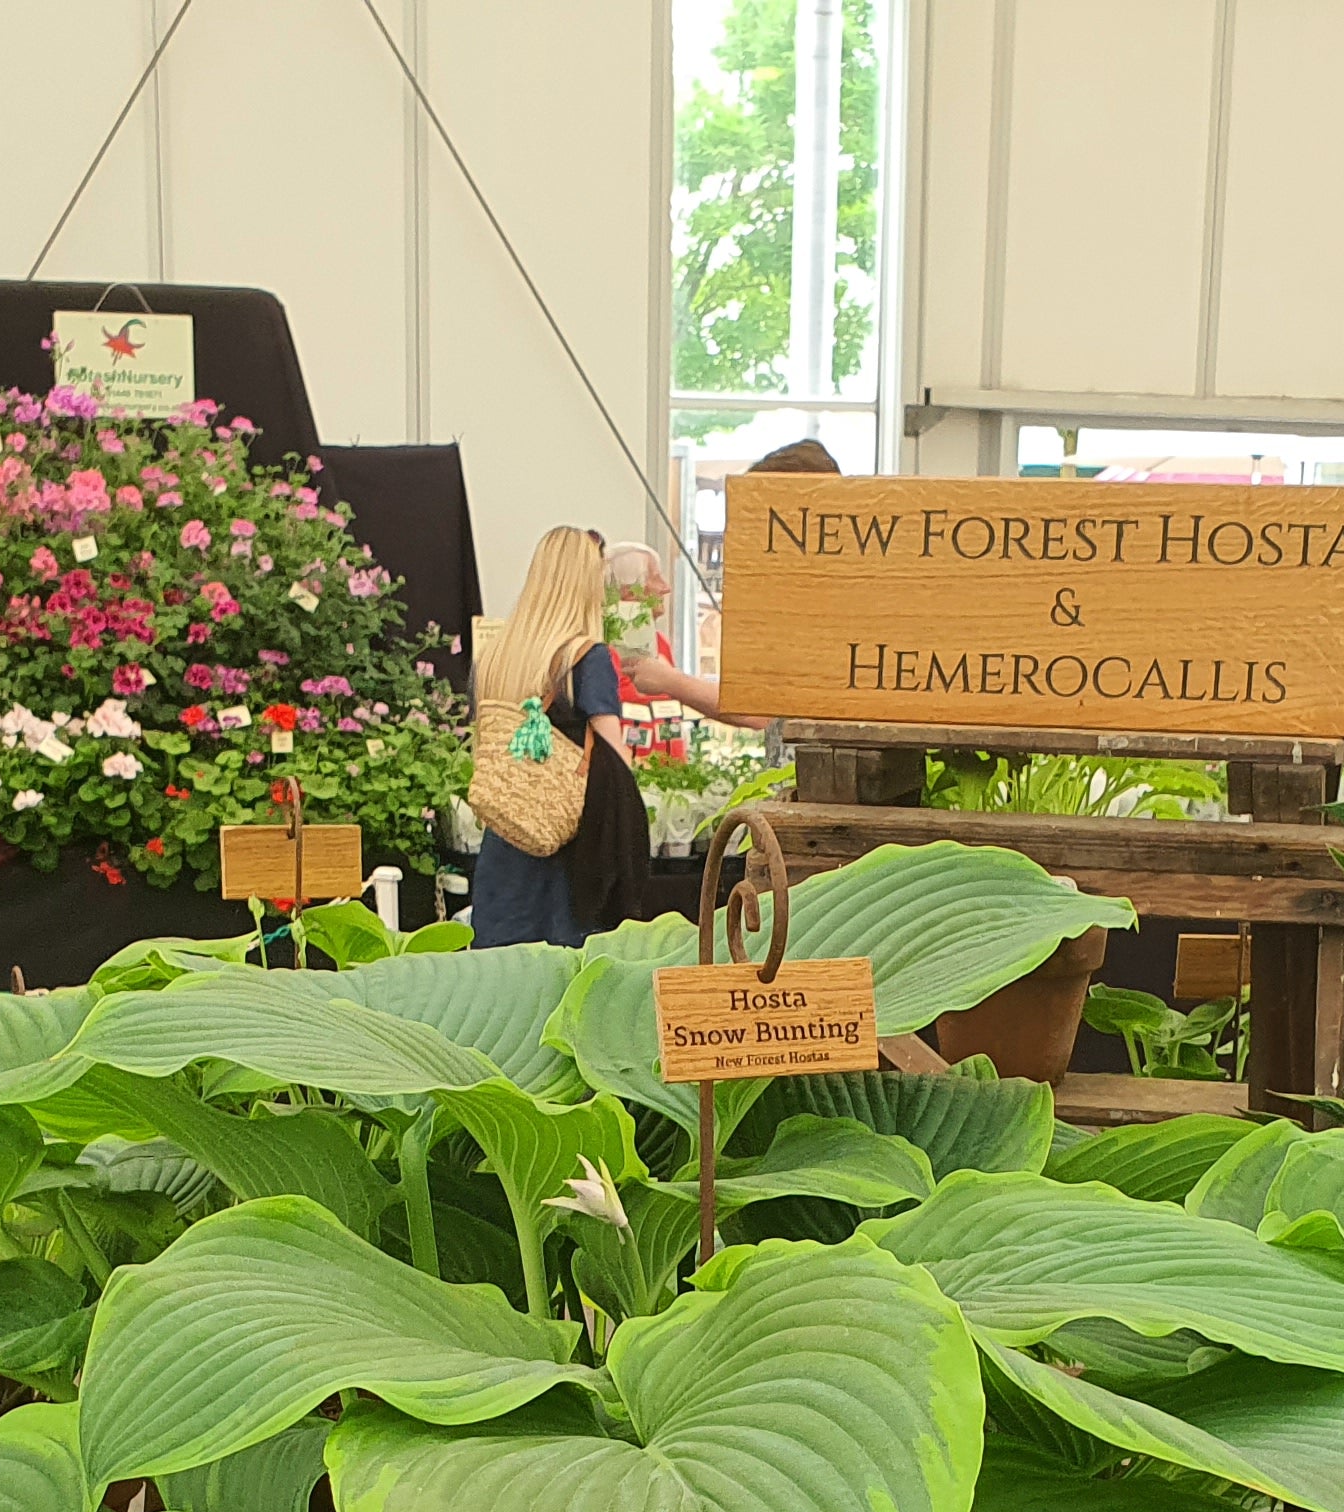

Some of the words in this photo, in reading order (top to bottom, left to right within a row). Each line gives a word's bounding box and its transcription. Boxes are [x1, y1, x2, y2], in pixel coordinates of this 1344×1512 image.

[763, 505, 903, 558] NEW
[918, 508, 1140, 563] FOREST
[1049, 586, 1085, 627] &
[846, 642, 1288, 705] HEMEROCALLIS
[727, 989, 808, 1012] Hosta
[715, 1056, 744, 1068] New
[746, 1053, 787, 1067] Forest
[788, 1050, 830, 1064] Hostas
